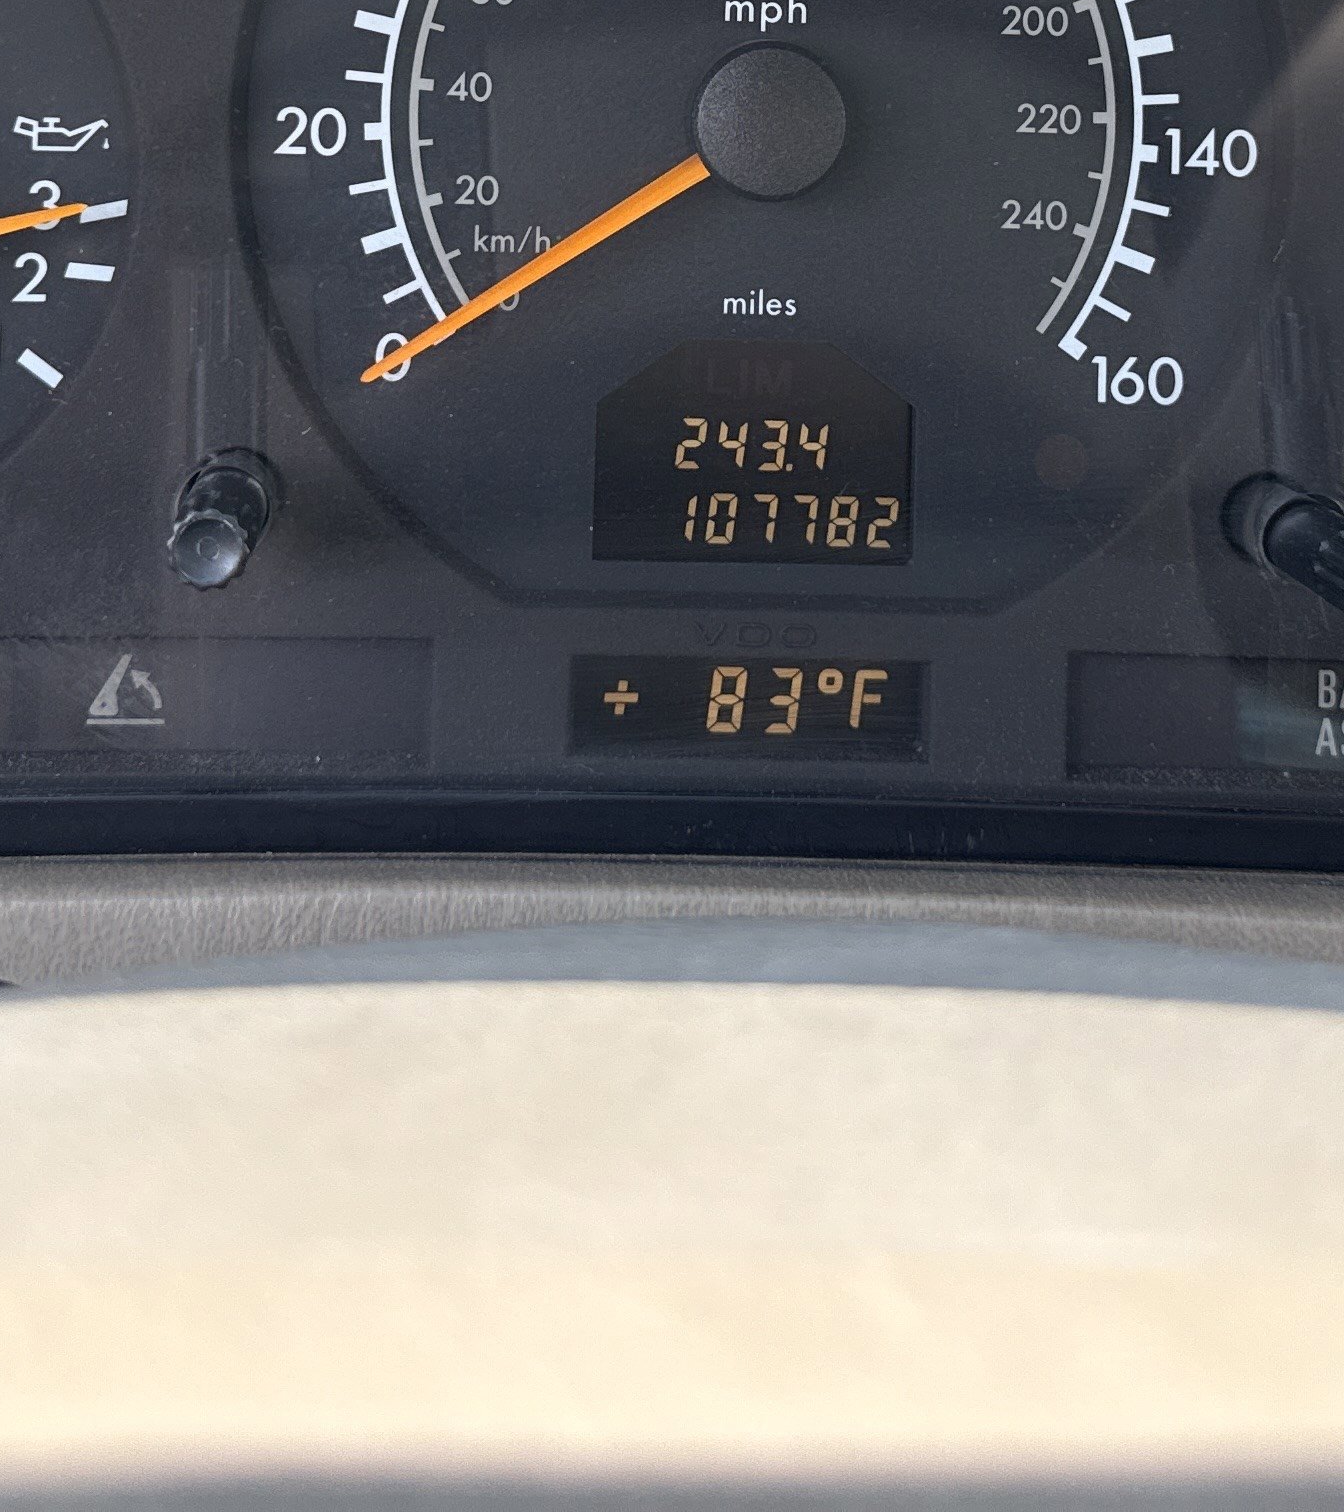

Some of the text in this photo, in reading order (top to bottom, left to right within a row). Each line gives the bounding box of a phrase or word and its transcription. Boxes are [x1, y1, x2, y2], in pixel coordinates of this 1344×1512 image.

[1000, 5, 1070, 37] 200
[446, 71, 493, 103] 40
[273, 106, 348, 157] 20
[1015, 103, 1082, 135] 220
[1164, 127, 1258, 178] 140
[28, 180, 62, 232] 3
[454, 174, 500, 206] 20
[1000, 199, 1069, 231] 240
[473, 224, 552, 255] km/h
[12, 253, 49, 304] 2
[723, 289, 797, 317] miles
[374, 331, 412, 382] 0
[1091, 355, 1184, 406] 160
[674, 416, 830, 472] 243.4
[684, 492, 900, 549] 107782
[693, 621, 818, 649] VDO
